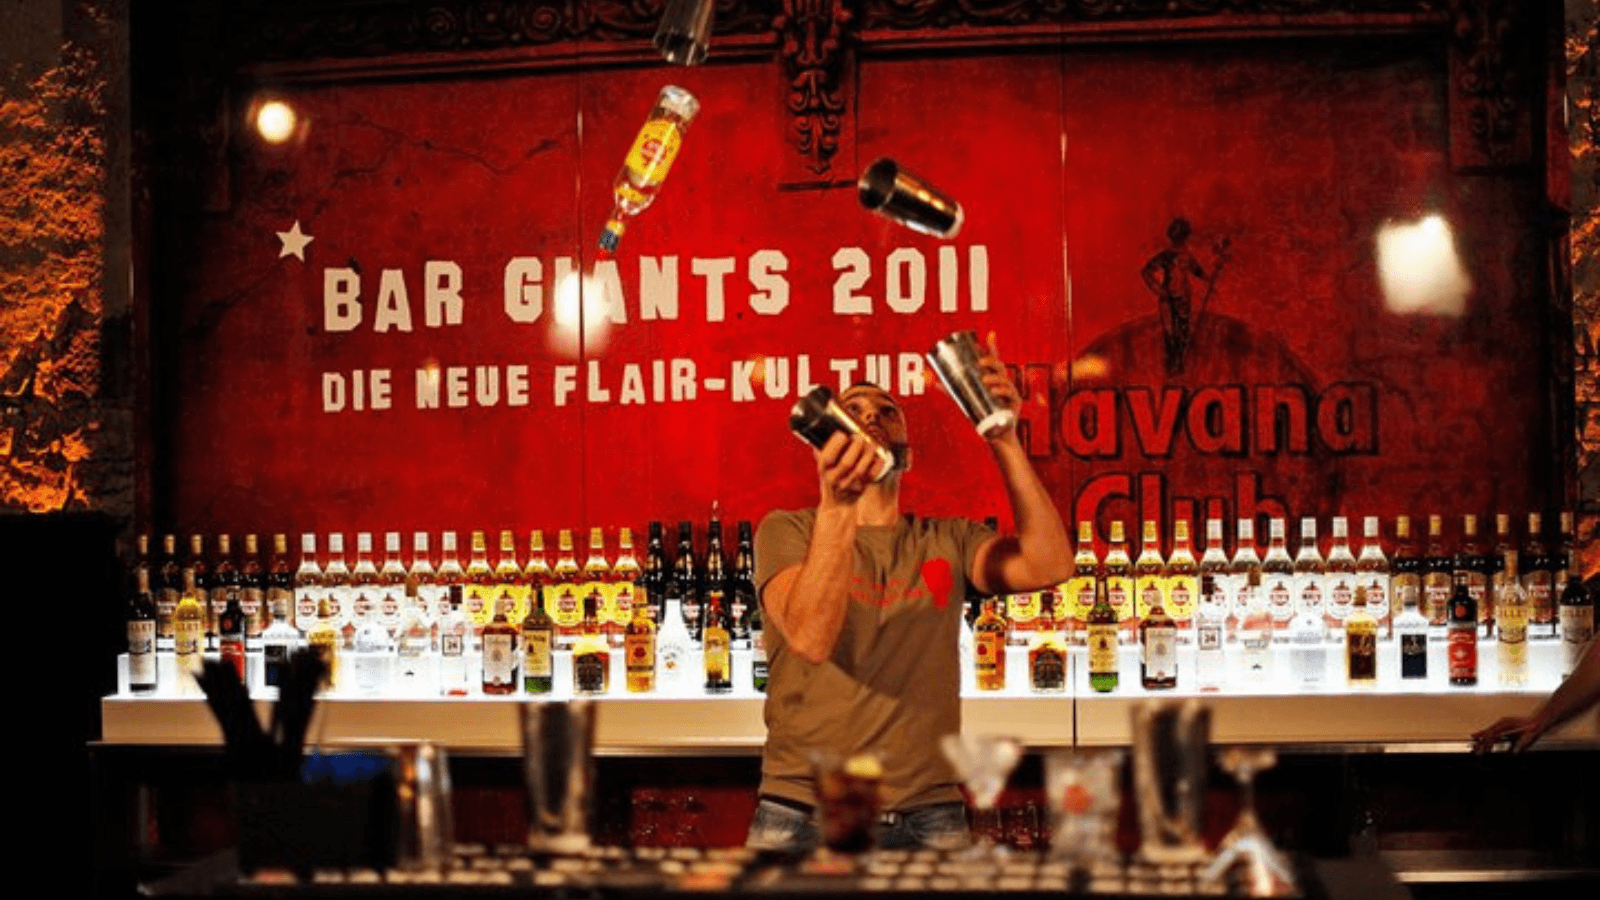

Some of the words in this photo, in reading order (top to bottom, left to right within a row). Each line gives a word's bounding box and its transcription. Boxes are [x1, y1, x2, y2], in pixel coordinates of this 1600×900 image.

[323, 259, 464, 333] BAR
[503, 249, 789, 324] GIANTS
[831, 244, 989, 315] 2011
[322, 368, 393, 413] DIE
[415, 363, 530, 410] NEUE
[553, 353, 926, 405] FLAIR-KULTUR
[1004, 363, 1380, 460] Havana
